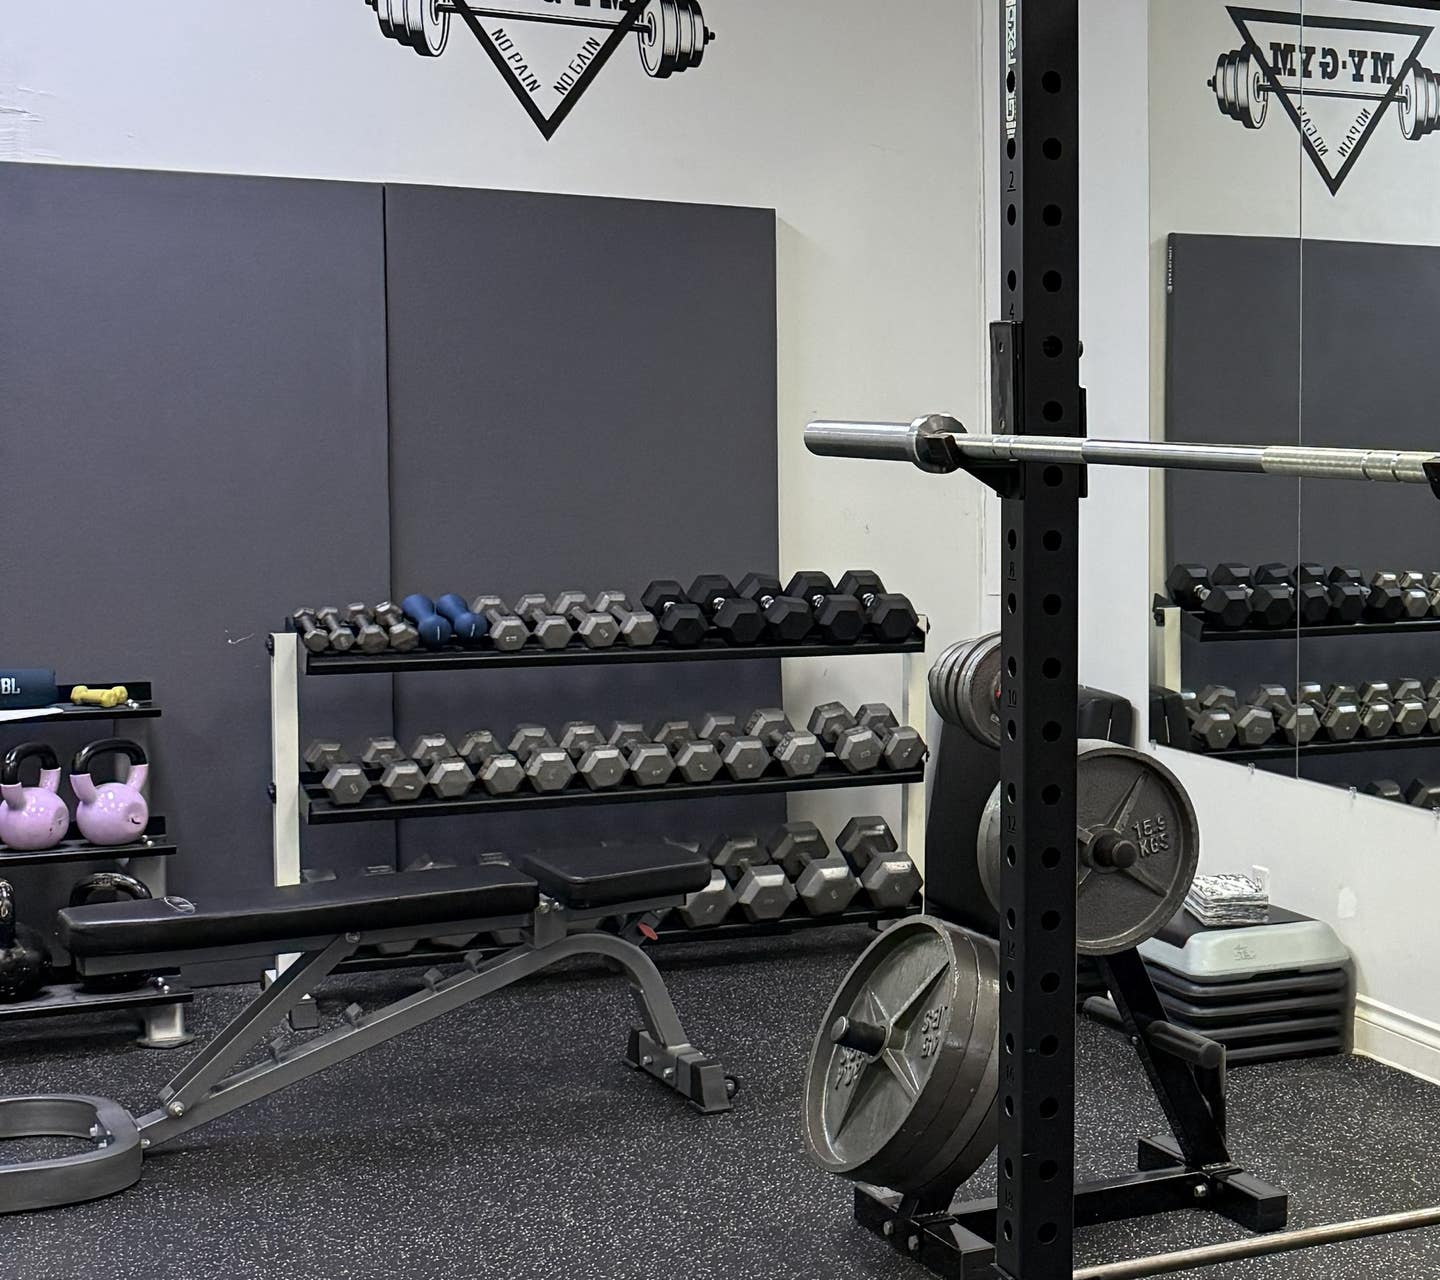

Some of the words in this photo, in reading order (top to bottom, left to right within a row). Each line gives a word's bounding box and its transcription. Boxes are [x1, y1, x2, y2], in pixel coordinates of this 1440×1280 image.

[491, 28, 514, 51] NO
[506, 51, 541, 93] PAIN
[553, 73, 574, 96] NO
[569, 37, 601, 74] GAIN
